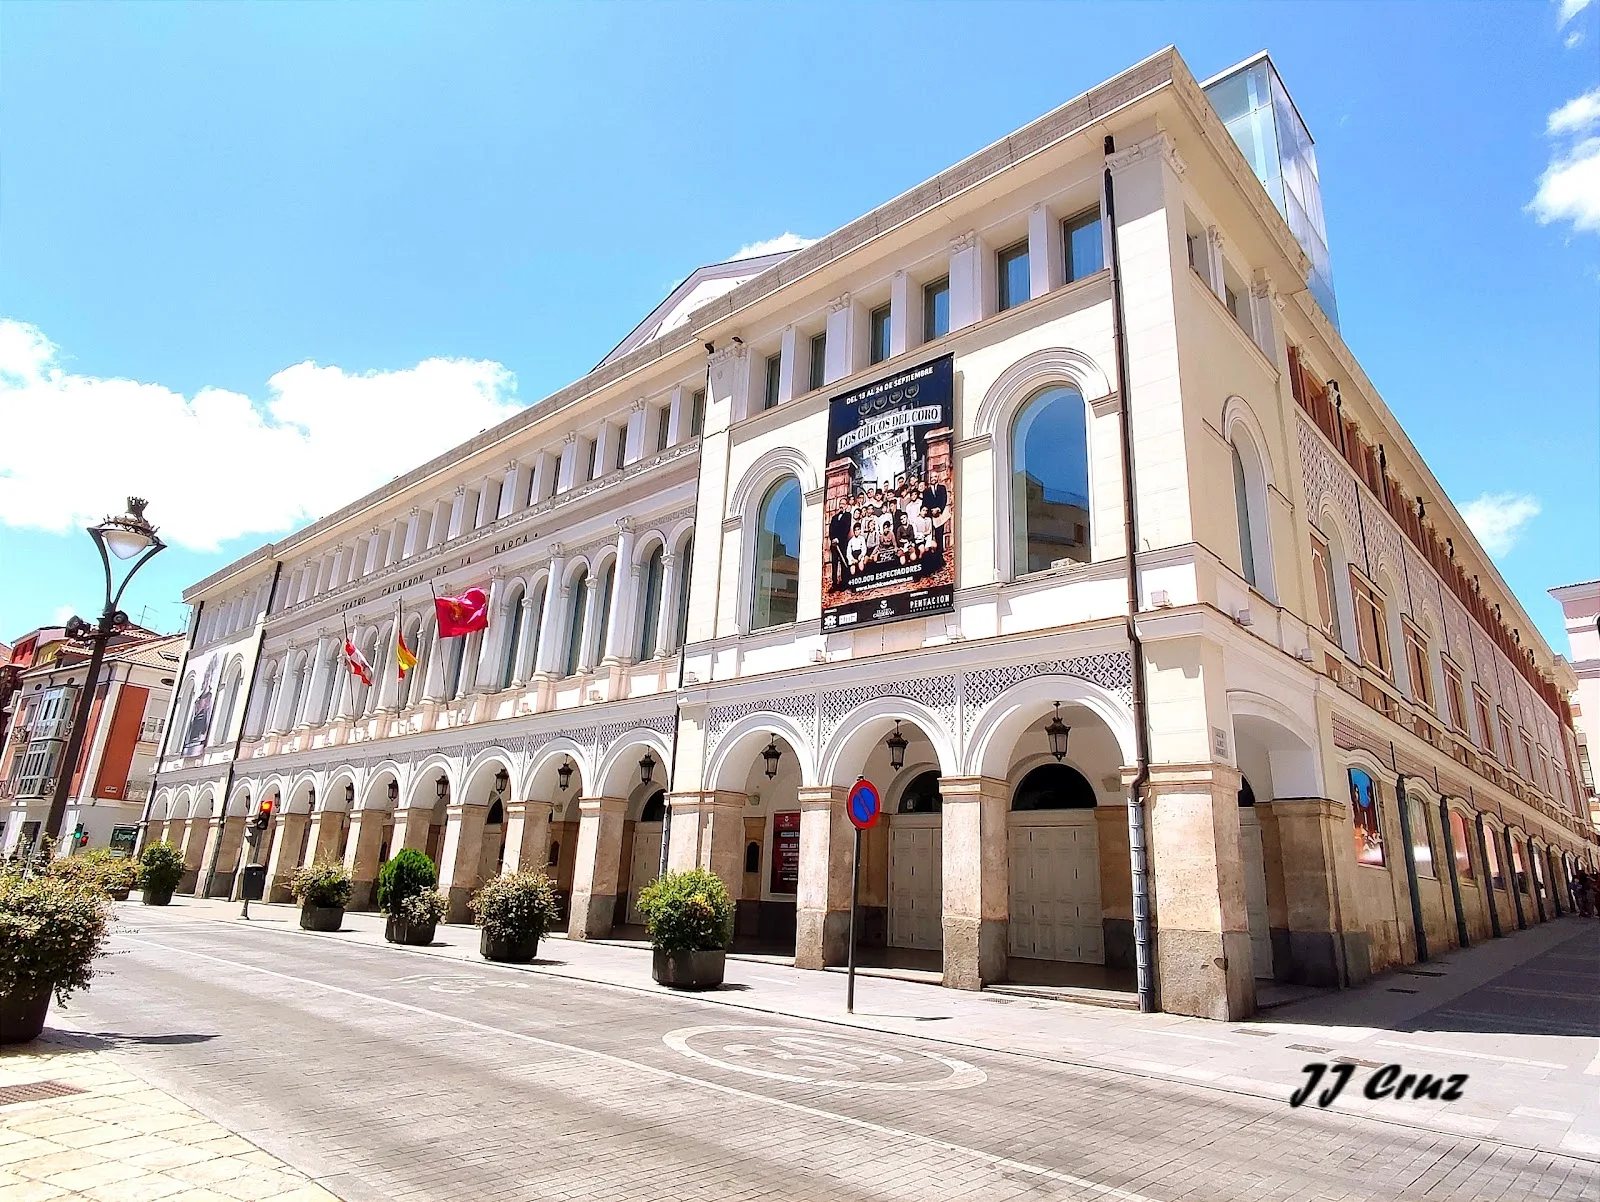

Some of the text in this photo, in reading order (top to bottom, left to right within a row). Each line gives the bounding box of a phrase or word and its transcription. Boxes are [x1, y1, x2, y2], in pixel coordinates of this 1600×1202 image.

[846, 395, 858, 405] DEL
[866, 388, 876, 397] AL
[884, 381, 893, 391] DE
[893, 366, 934, 387] SEPTIEMBRE
[839, 432, 857, 450] LOS
[857, 419, 891, 440] CHICOS
[892, 413, 910, 427] DEL
[911, 408, 938, 422] CORO
[341, 534, 529, 611] TEATRO CALDERON DE LA BARCA
[875, 564, 922, 580] ESPECTADORES
